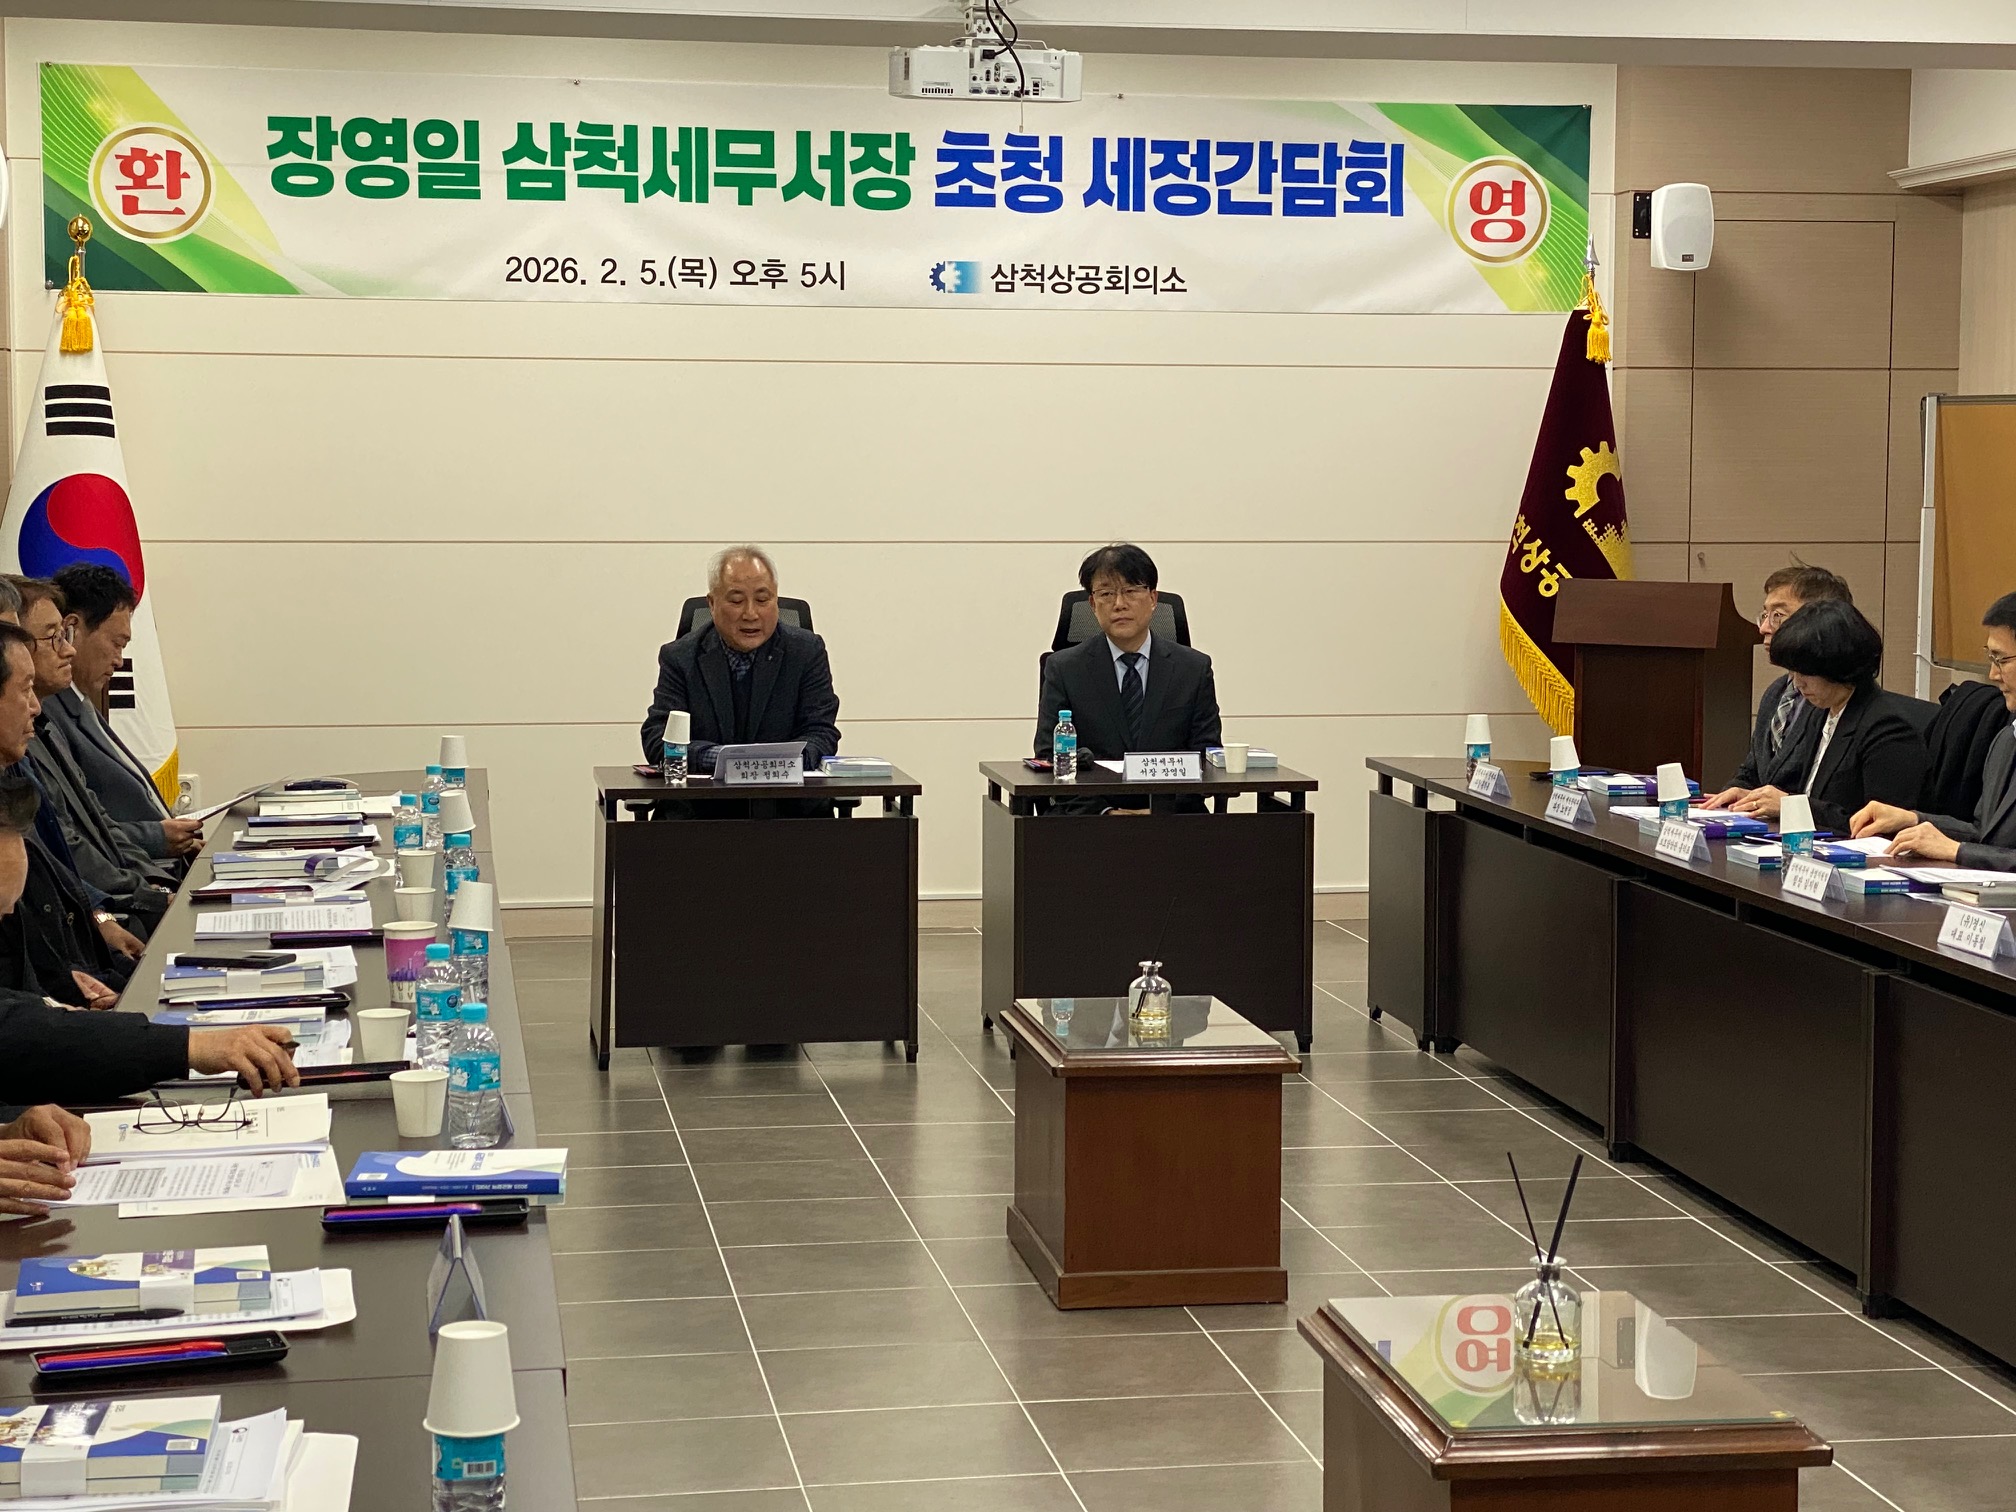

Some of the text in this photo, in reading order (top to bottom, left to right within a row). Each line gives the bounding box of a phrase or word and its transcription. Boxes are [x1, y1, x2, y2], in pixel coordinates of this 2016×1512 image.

[268, 116, 1404, 217] 장영일 삼척세무서장 초청 세정간담회
[115, 147, 191, 216] 환
[1468, 179, 1527, 244] 영
[505, 256, 846, 292] 2026. 2. 5.(목) 오후 5시
[990, 263, 1188, 295] 삼척상공회의소
[733, 760, 796, 770] 삼척상공회의소
[1140, 767, 1186, 777] 서장 장영일
[1141, 757, 1184, 767] 삼척세무서
[741, 771, 759, 780] 회장
[1950, 927, 1964, 941] 대표
